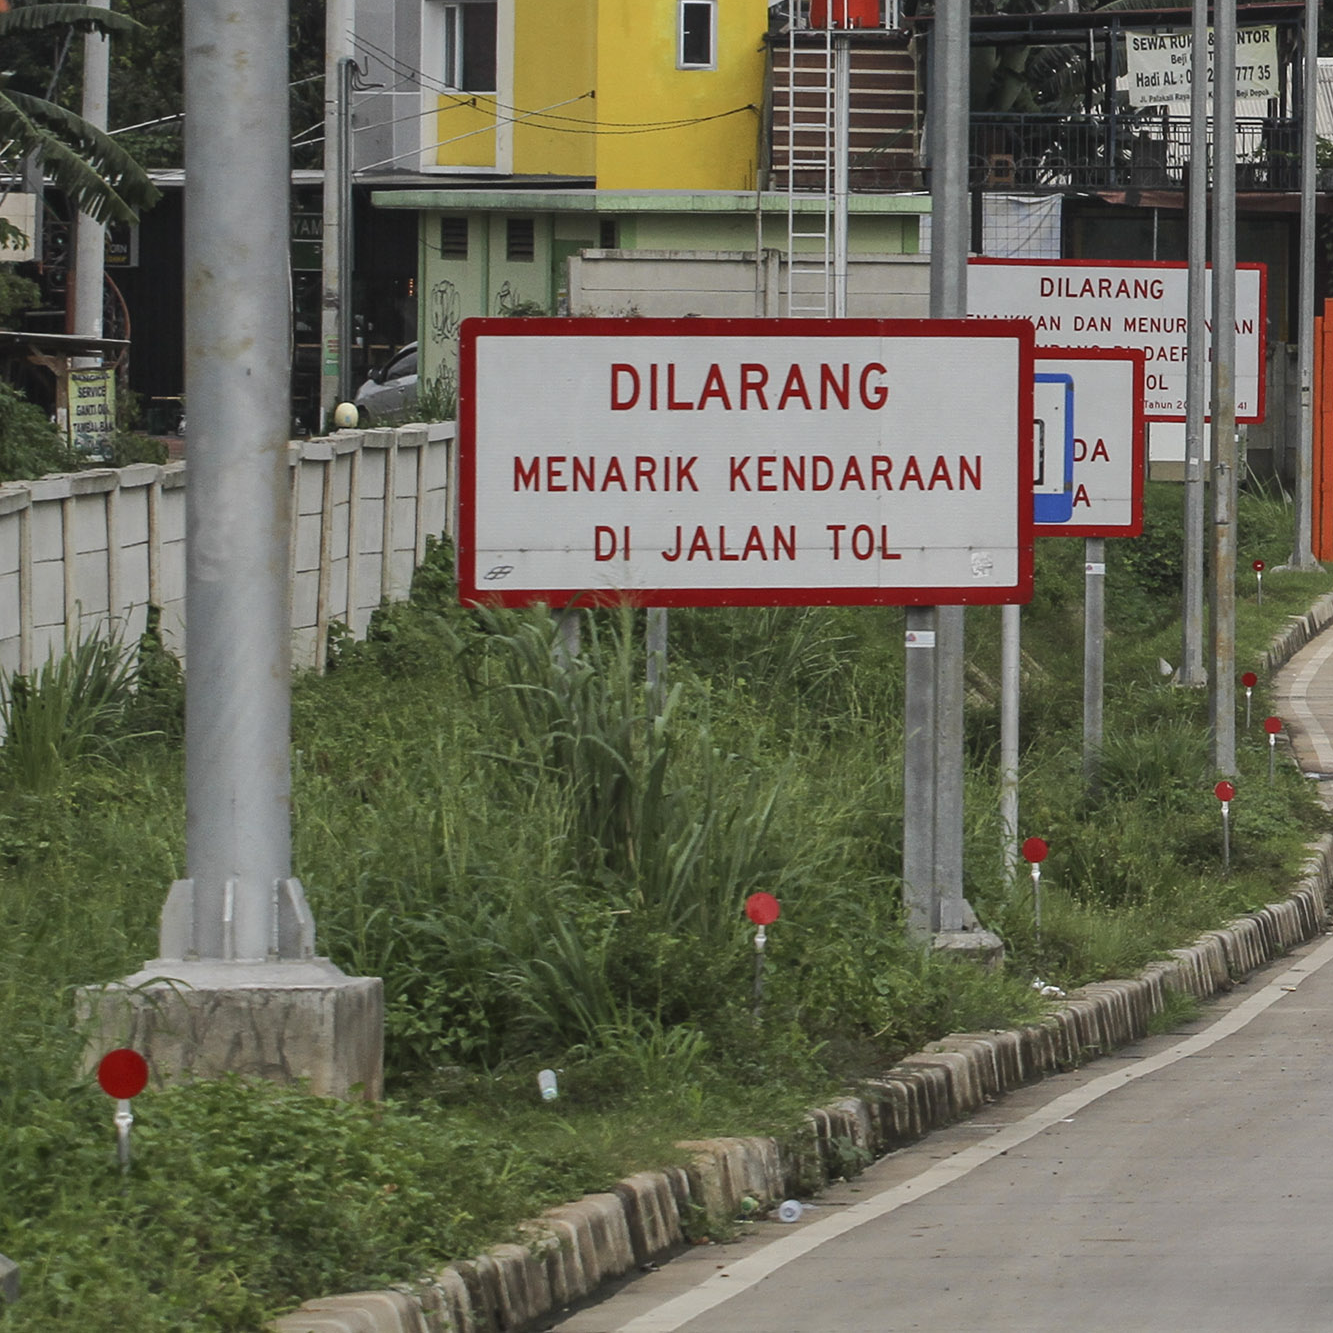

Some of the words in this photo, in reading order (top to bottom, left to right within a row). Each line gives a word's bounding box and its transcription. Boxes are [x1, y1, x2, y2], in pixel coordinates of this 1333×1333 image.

[1133, 37, 1167, 51] SEWA
[1170, 35, 1192, 49] RUK
[1207, 32, 1214, 46] &
[1235, 30, 1270, 45] NTOR
[1171, 53, 1187, 66] Beji
[1136, 71, 1160, 87] Hadi
[1163, 71, 1177, 86] AL
[1040, 277, 1164, 299] DILARANG
[1074, 316, 1111, 332] DAN
[610, 362, 890, 411] DILARANG
[1145, 374, 1169, 390] OL
[78, 386, 106, 398] SERVICE
[1144, 401, 1173, 410] Tahun
[1073, 438, 1110, 462] DA
[513, 456, 698, 492] MENARIK
[730, 455, 982, 491] KENDARAAN
[594, 526, 630, 561] DI
[662, 525, 796, 561] JALAN
[827, 525, 902, 560] TOL
